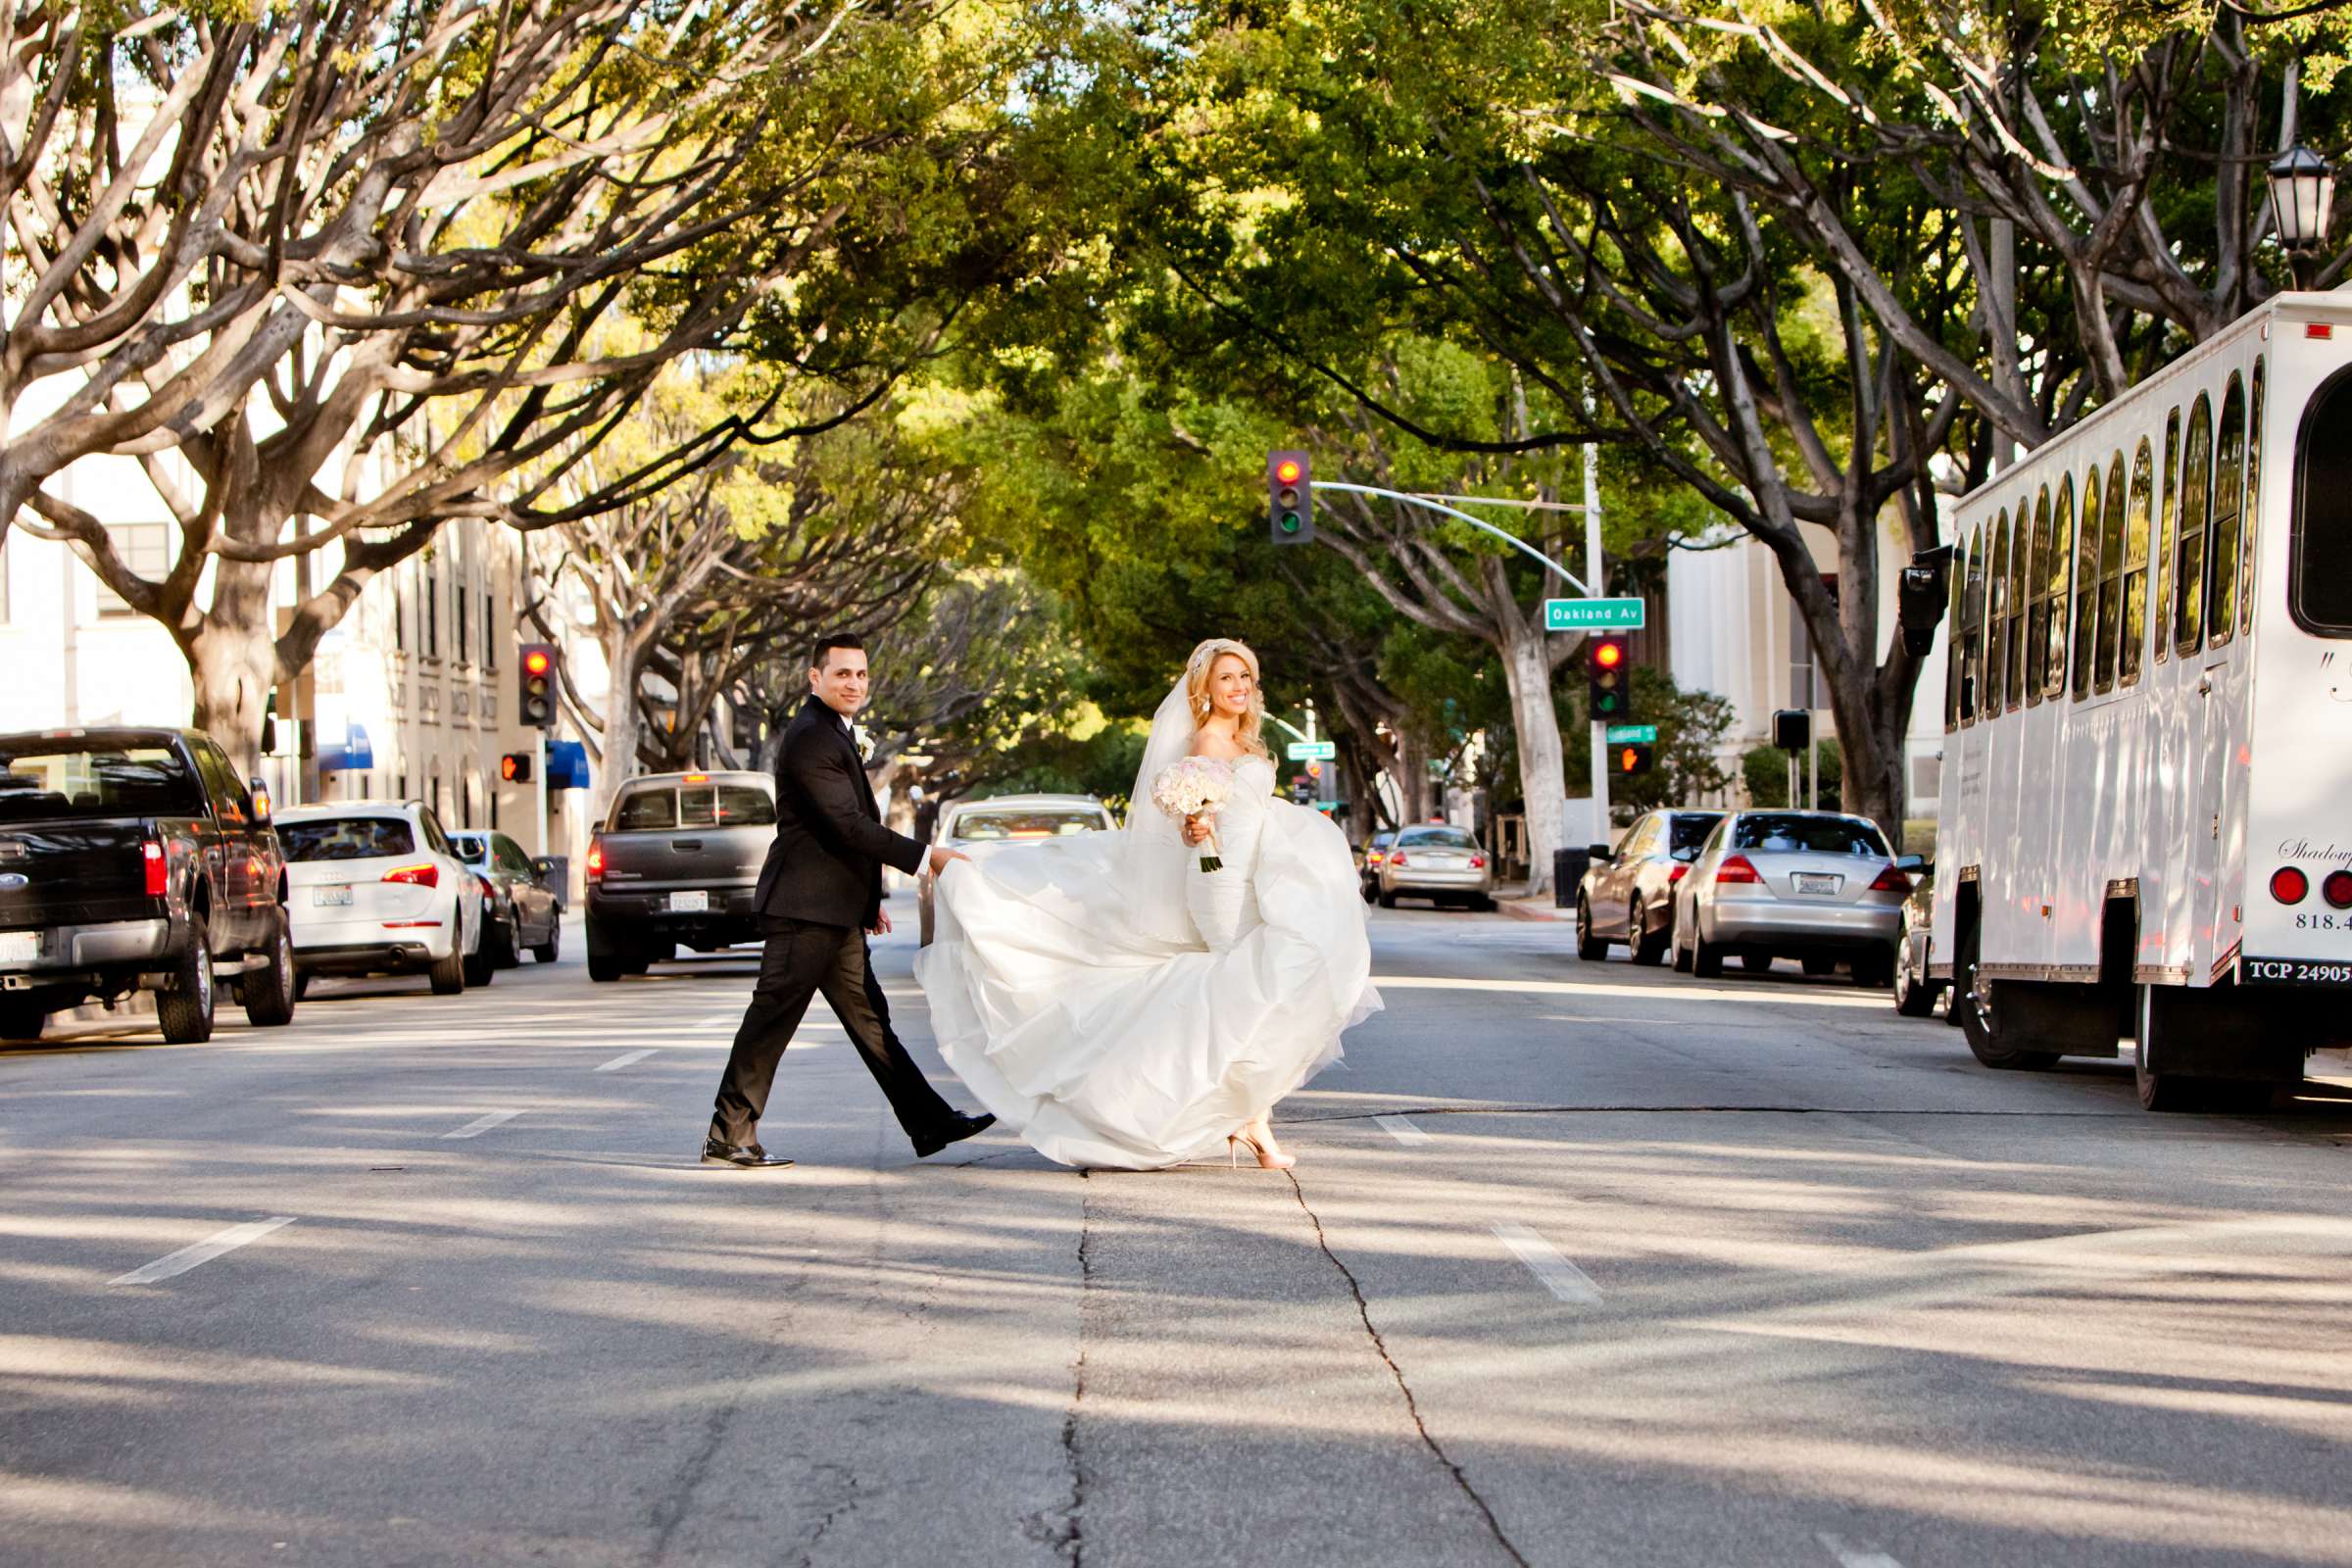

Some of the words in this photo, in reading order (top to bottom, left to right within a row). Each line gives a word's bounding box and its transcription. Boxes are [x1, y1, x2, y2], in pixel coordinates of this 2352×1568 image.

[1553, 608, 1612, 620] Oakland
[1620, 608, 1638, 619] Av
[2250, 961, 2293, 979] TCP
[2296, 964, 2352, 982] 24905
